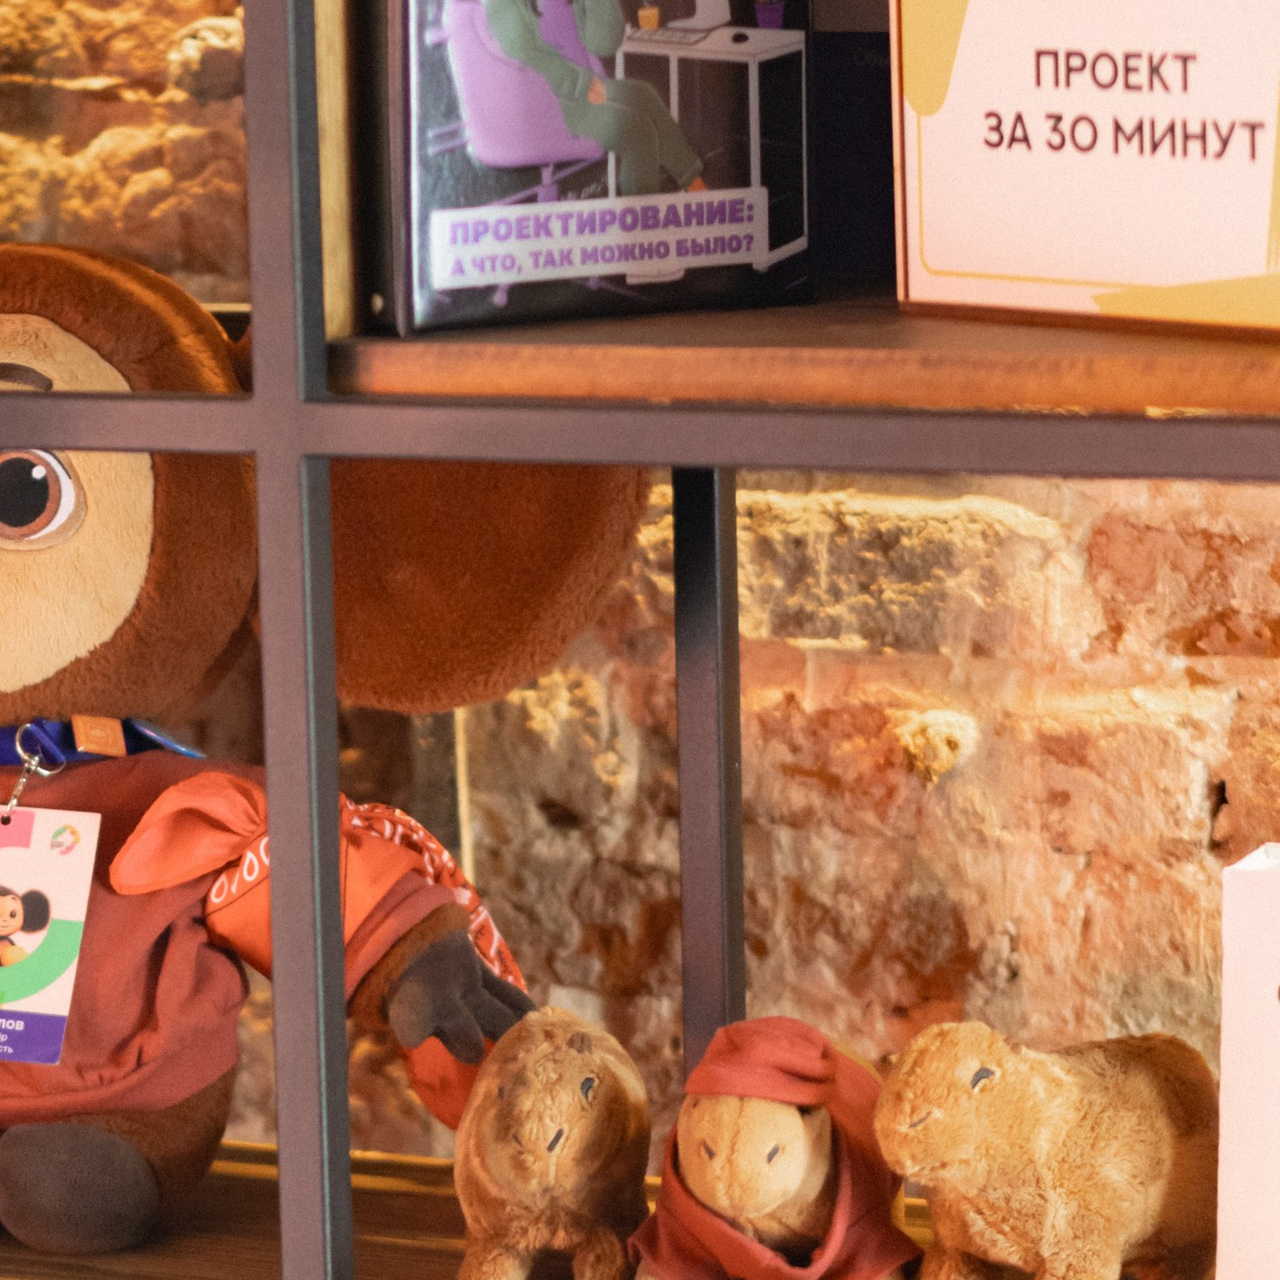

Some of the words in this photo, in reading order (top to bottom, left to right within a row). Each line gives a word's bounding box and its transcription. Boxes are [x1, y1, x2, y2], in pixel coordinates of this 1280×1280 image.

[1035, 49, 1197, 93] ПРОЕКТ
[984, 111, 1032, 152] ЗА
[1045, 112, 1099, 153] 30
[1112, 116, 1265, 162] МИНУТ
[450, 197, 755, 246] ПРОЕКТИРОВАНИЕ:
[451, 253, 466, 276] А
[470, 251, 523, 275] ЧТО,
[529, 247, 575, 269] ТАК
[579, 240, 671, 266] МОЖНО
[676, 233, 755, 258] БЫЛО?
